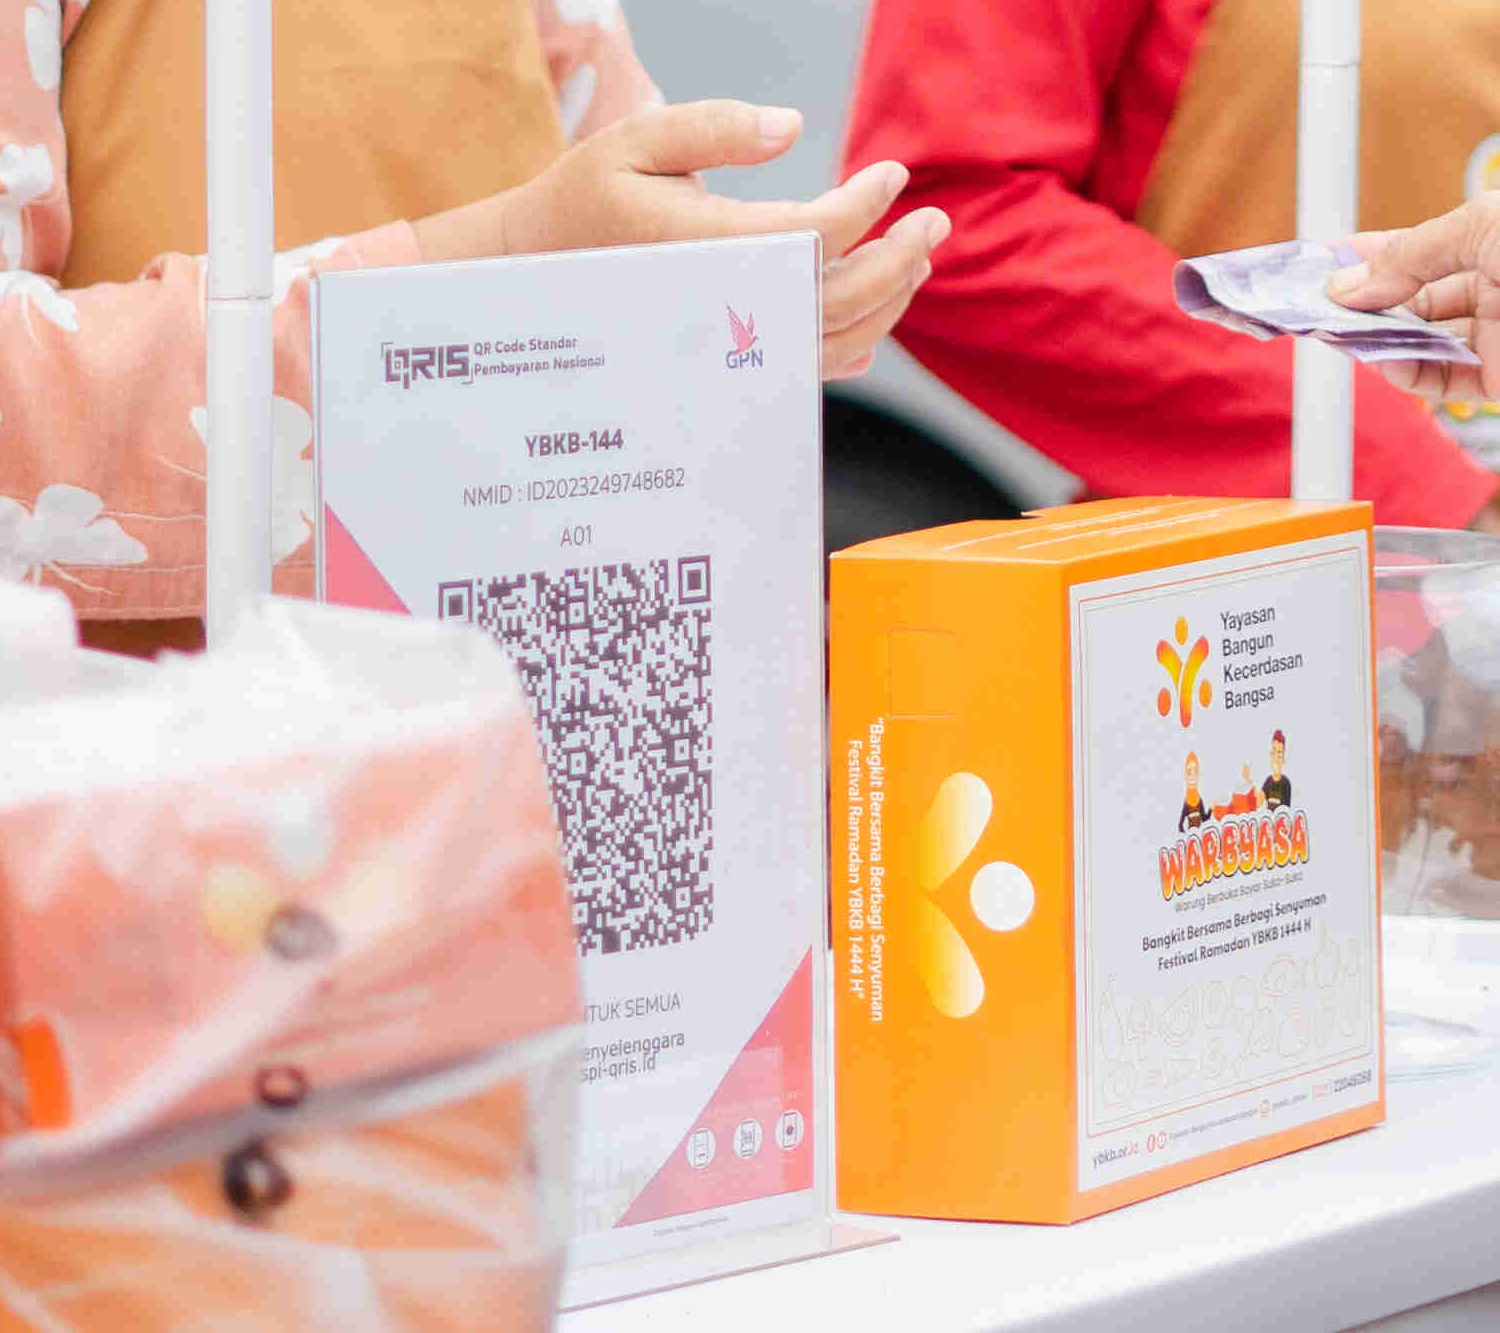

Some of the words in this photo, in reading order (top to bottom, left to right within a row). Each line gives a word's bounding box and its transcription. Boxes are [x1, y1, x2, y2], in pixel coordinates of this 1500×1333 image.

[474, 341, 491, 356] QR
[495, 339, 526, 354] Code
[529, 336, 577, 352] Standar
[725, 348, 764, 371] GPN
[384, 342, 471, 389] QRIS
[474, 360, 550, 377] Pembayaran
[553, 354, 605, 371] Nasional
[524, 428, 624, 458] YBKB-144
[463, 484, 513, 508] NMID
[527, 467, 686, 502] ID2023249748682
[560, 524, 593, 547] A01
[1220, 605, 1276, 631] Yayasan
[1221, 633, 1274, 657] Bangun
[1222, 651, 1304, 684] Kecerdasan
[1224, 684, 1275, 710] Bangsa
[848, 740, 863, 802] Festival
[869, 791, 885, 862] Bersama
[848, 806, 864, 884] Ramadan
[1157, 805, 1311, 901] WARBYASA
[848, 887, 864, 930] YBKB
[867, 866, 885, 929] Berbagi
[1142, 927, 1186, 951] Bangkit
[1187, 918, 1232, 941] Bersama
[1234, 903, 1274, 928] Berbagi
[1275, 893, 1327, 916] Senyuman
[848, 935, 864, 975] 1444
[1158, 948, 1198, 971] Festival
[1199, 935, 1251, 960] Ramadan
[1251, 926, 1280, 947] YBKB
[1280, 921, 1302, 940] 1444
[1303, 917, 1313, 933] H
[867, 933, 886, 1022] Senyuman
[624, 992, 682, 1019] SEMUA
[580, 1032, 685, 1062] enyelenggara
[580, 1052, 656, 1084] spi-qris.id
